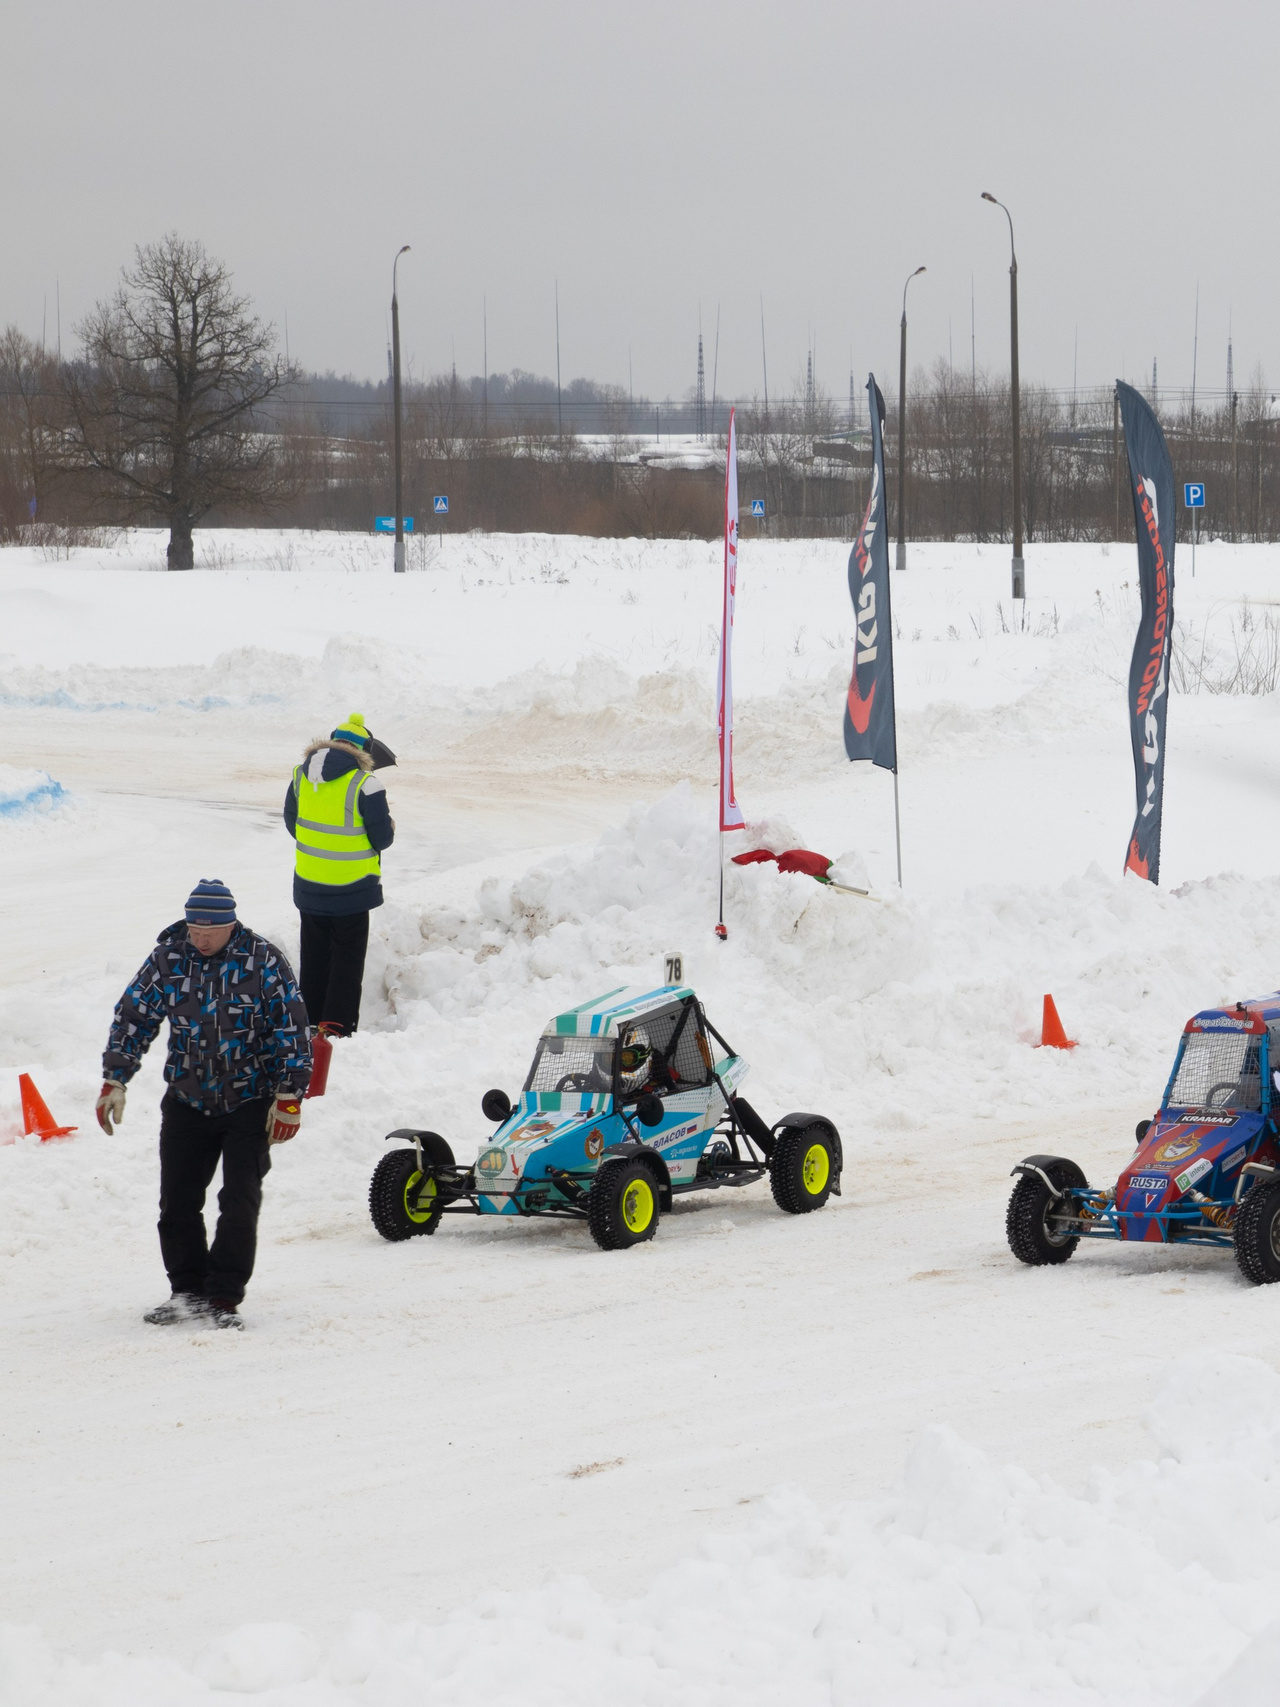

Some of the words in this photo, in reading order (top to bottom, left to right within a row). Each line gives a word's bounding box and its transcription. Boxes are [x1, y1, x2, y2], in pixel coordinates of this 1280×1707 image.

[666, 958, 682, 982] 78
[1181, 1114, 1233, 1124] KRAMAR
[653, 1127, 686, 1149] ВЛАСОВ
[1189, 1160, 1210, 1178] integra
[1129, 1178, 1167, 1188] RUSTA
